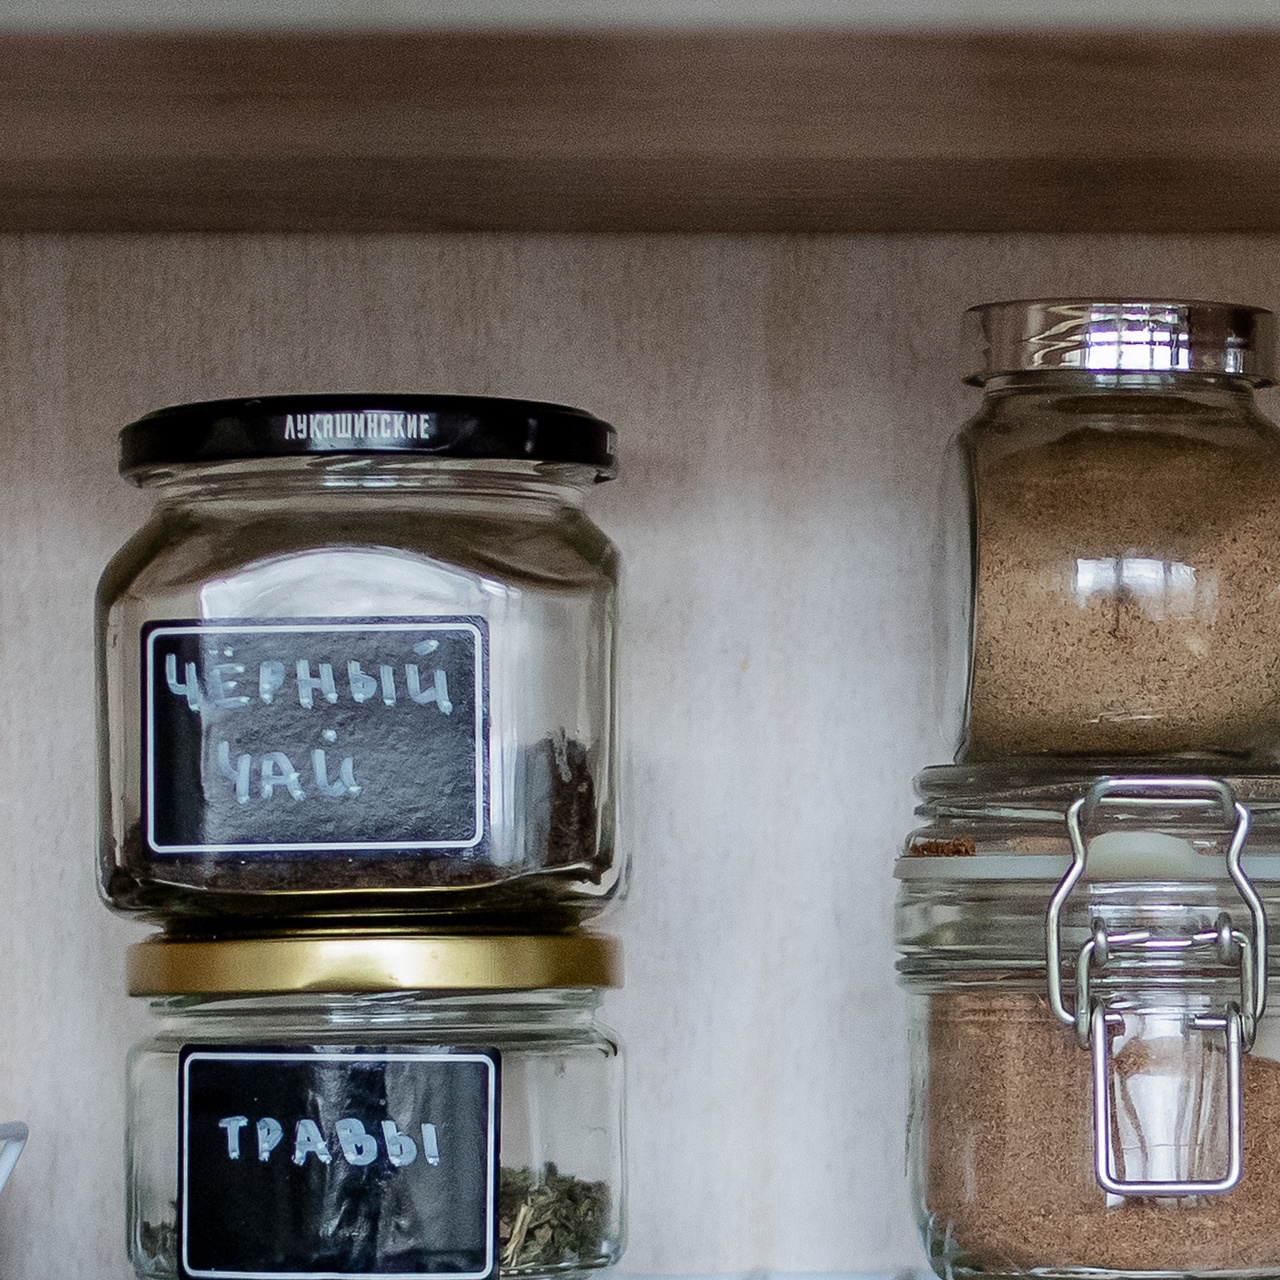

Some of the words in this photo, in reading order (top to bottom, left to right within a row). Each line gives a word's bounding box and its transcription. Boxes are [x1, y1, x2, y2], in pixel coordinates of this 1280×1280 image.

[284, 414, 430, 440] ЛУКАШИНСКИЕ
[166, 640, 453, 715] ЧЁРНЫЙ
[217, 729, 363, 805] ЧАЙ
[218, 1115, 440, 1167] ТРАВЫ
